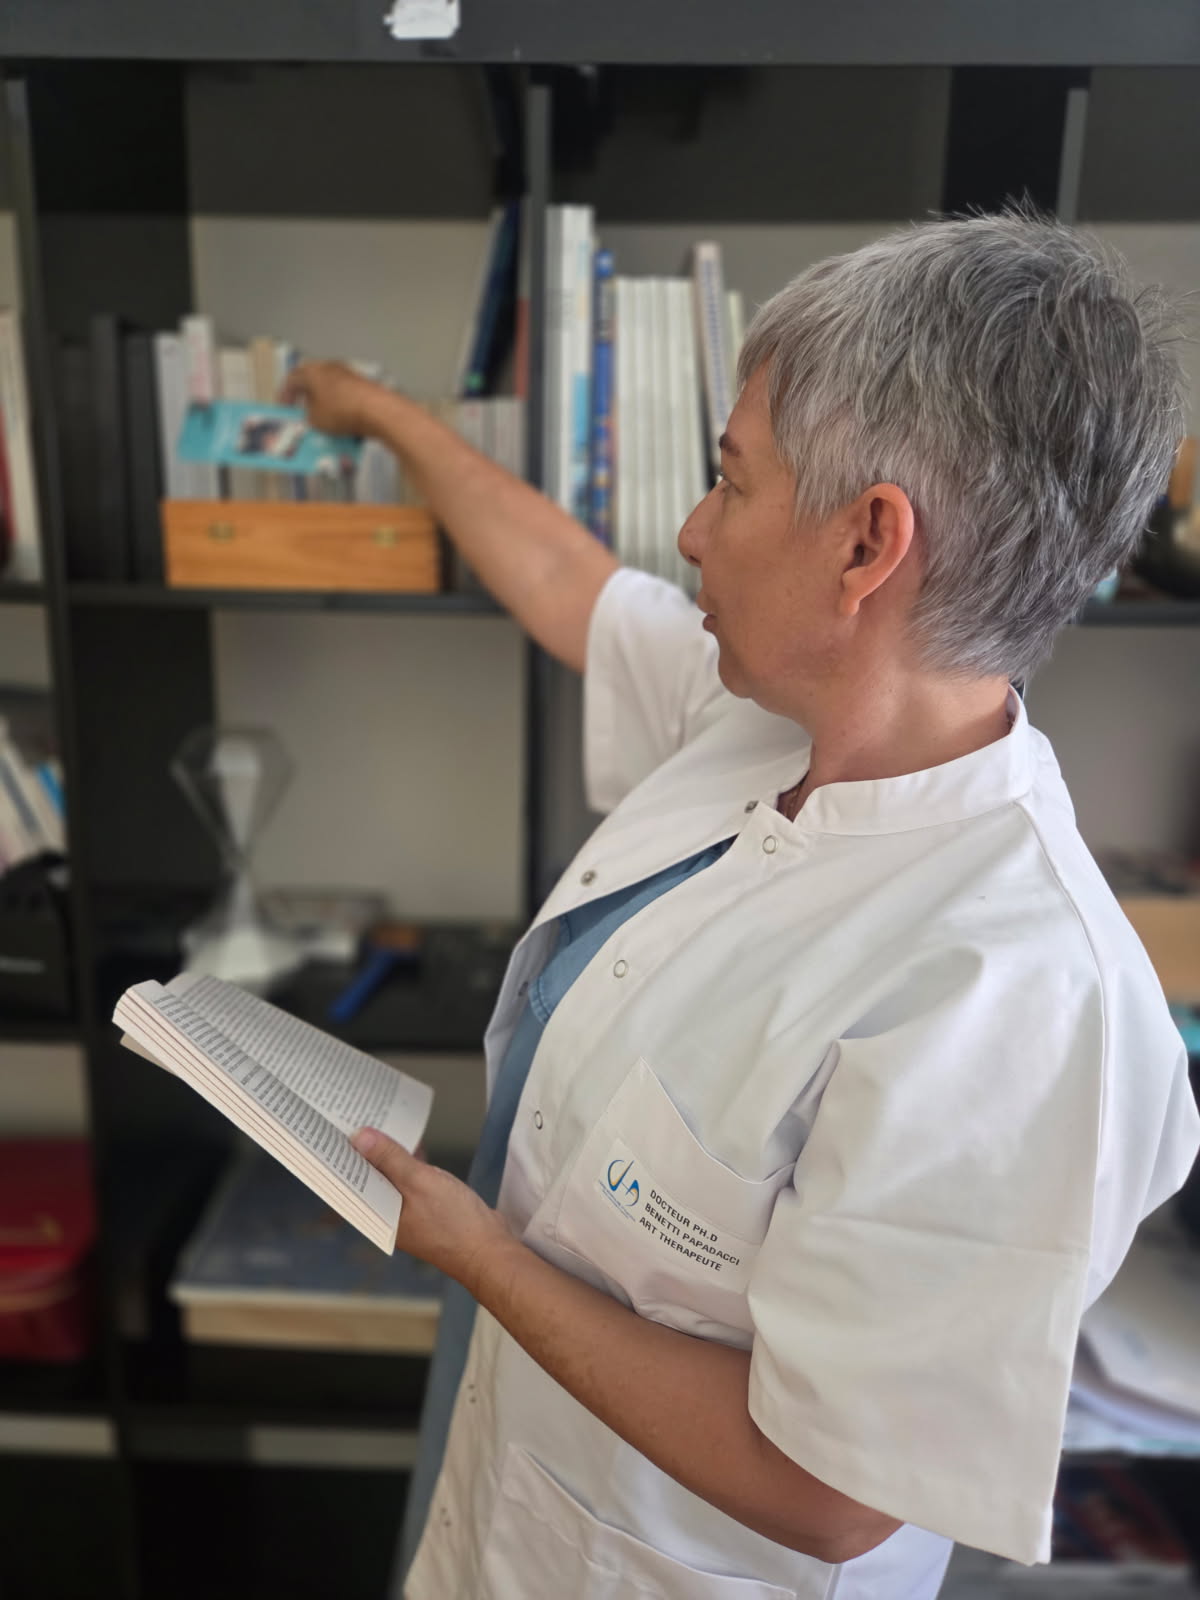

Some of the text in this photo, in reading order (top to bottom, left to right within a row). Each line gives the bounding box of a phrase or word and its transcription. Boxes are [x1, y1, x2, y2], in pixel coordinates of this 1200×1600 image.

[639, 1216, 723, 1272] ART THERAPEUTE
[644, 1202, 741, 1266] BENETTI PAPADACCI
[650, 1189, 690, 1228] DOCTEUR
[692, 1223, 719, 1243] PH.D
